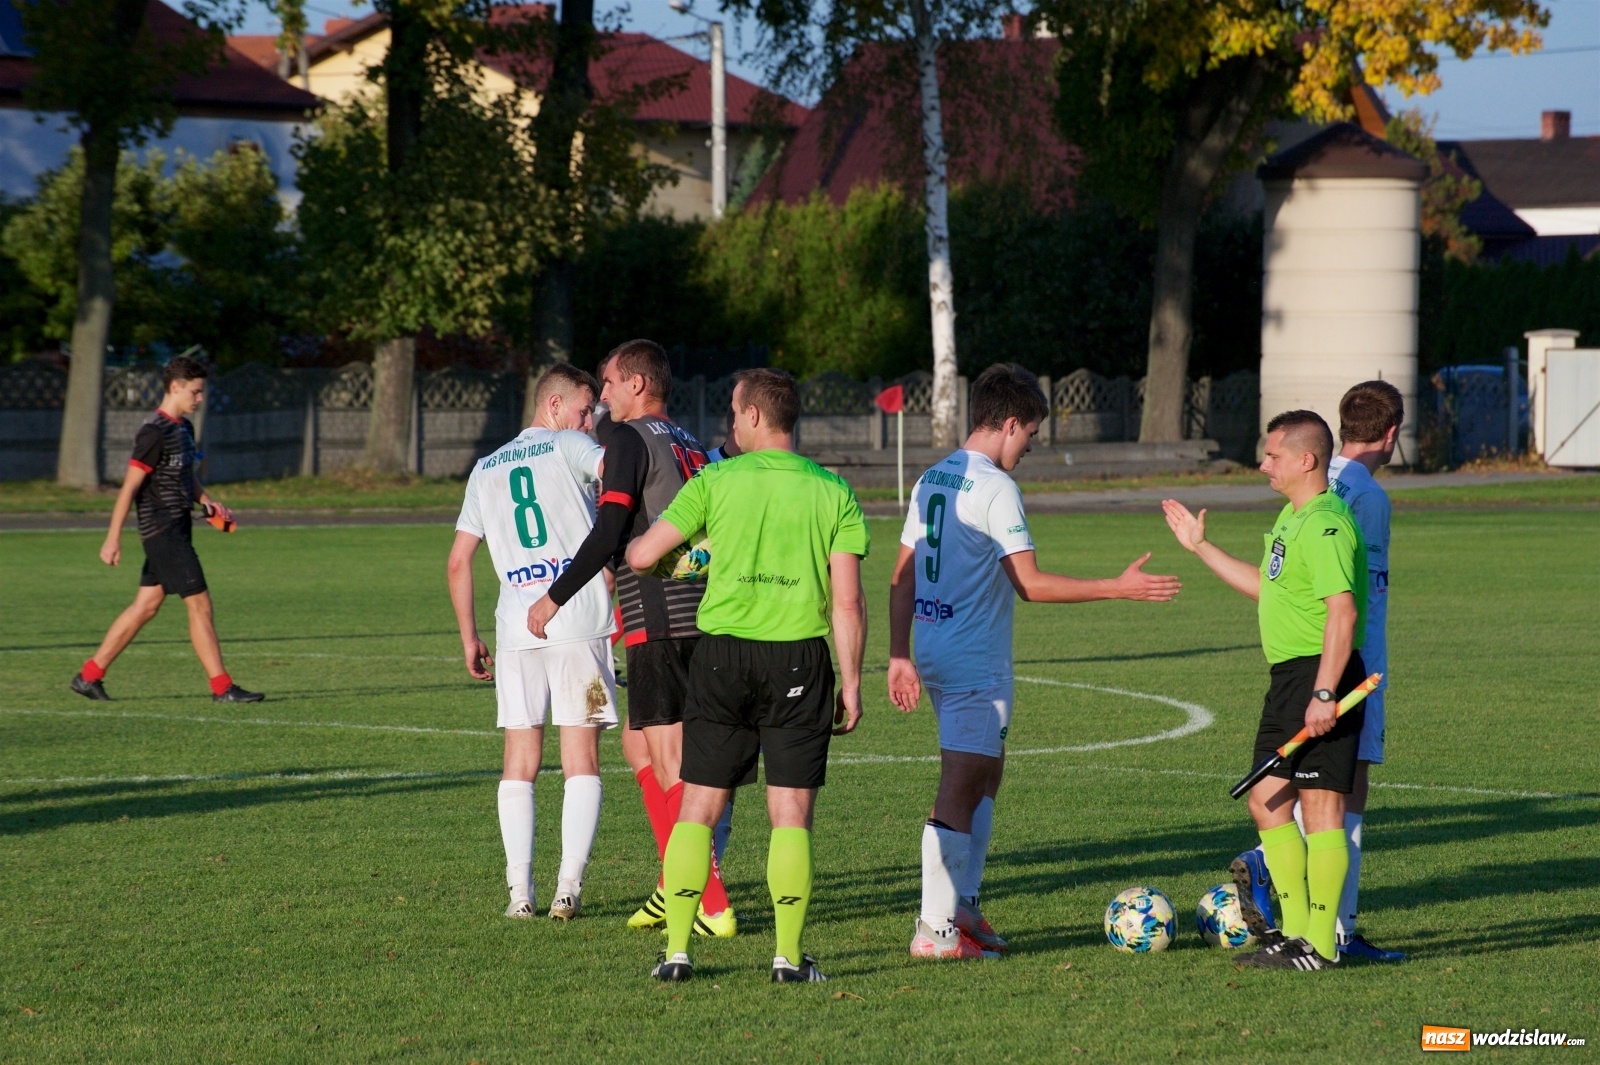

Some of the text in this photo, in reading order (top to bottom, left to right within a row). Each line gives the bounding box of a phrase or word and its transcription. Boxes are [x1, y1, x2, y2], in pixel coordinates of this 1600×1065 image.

[498, 447, 526, 465] POLONA
[508, 466, 548, 549] 8
[925, 493, 947, 584] 9
